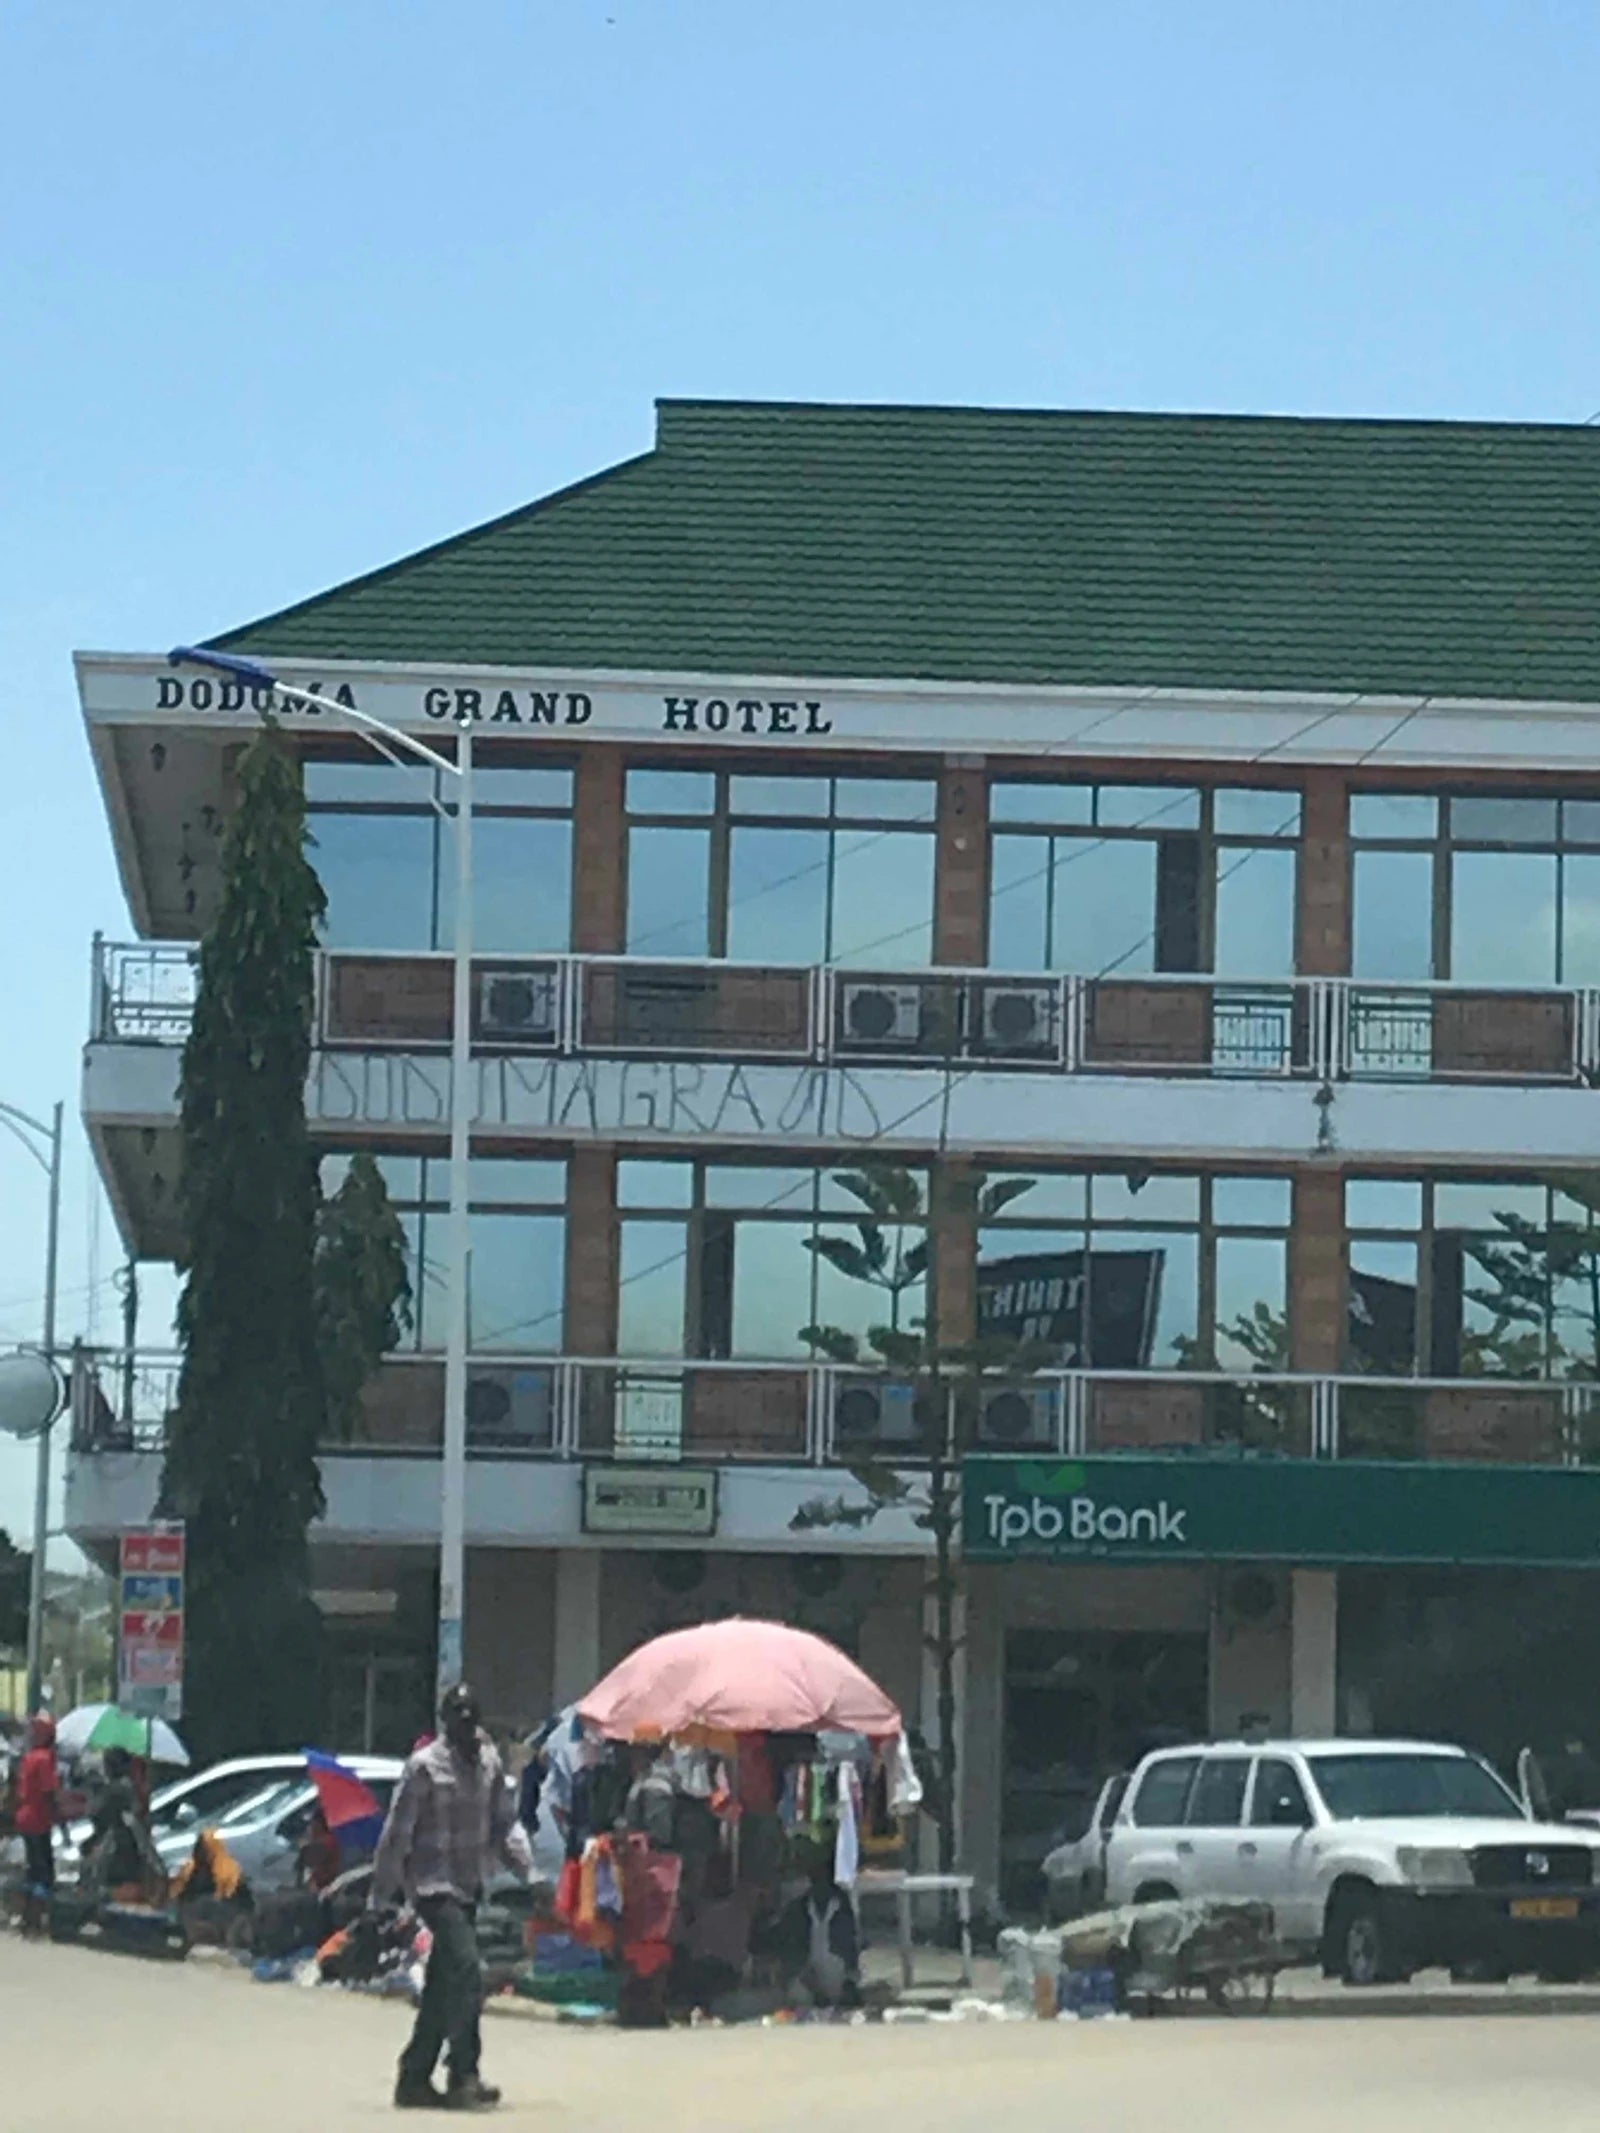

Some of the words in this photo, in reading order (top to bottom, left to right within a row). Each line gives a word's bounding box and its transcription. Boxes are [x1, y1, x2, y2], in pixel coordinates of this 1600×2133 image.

[424, 688, 593, 724] GRAND
[662, 697, 832, 734] HOTEL
[984, 1495, 1063, 1547] Tpb
[1070, 1498, 1186, 1541] Bank
